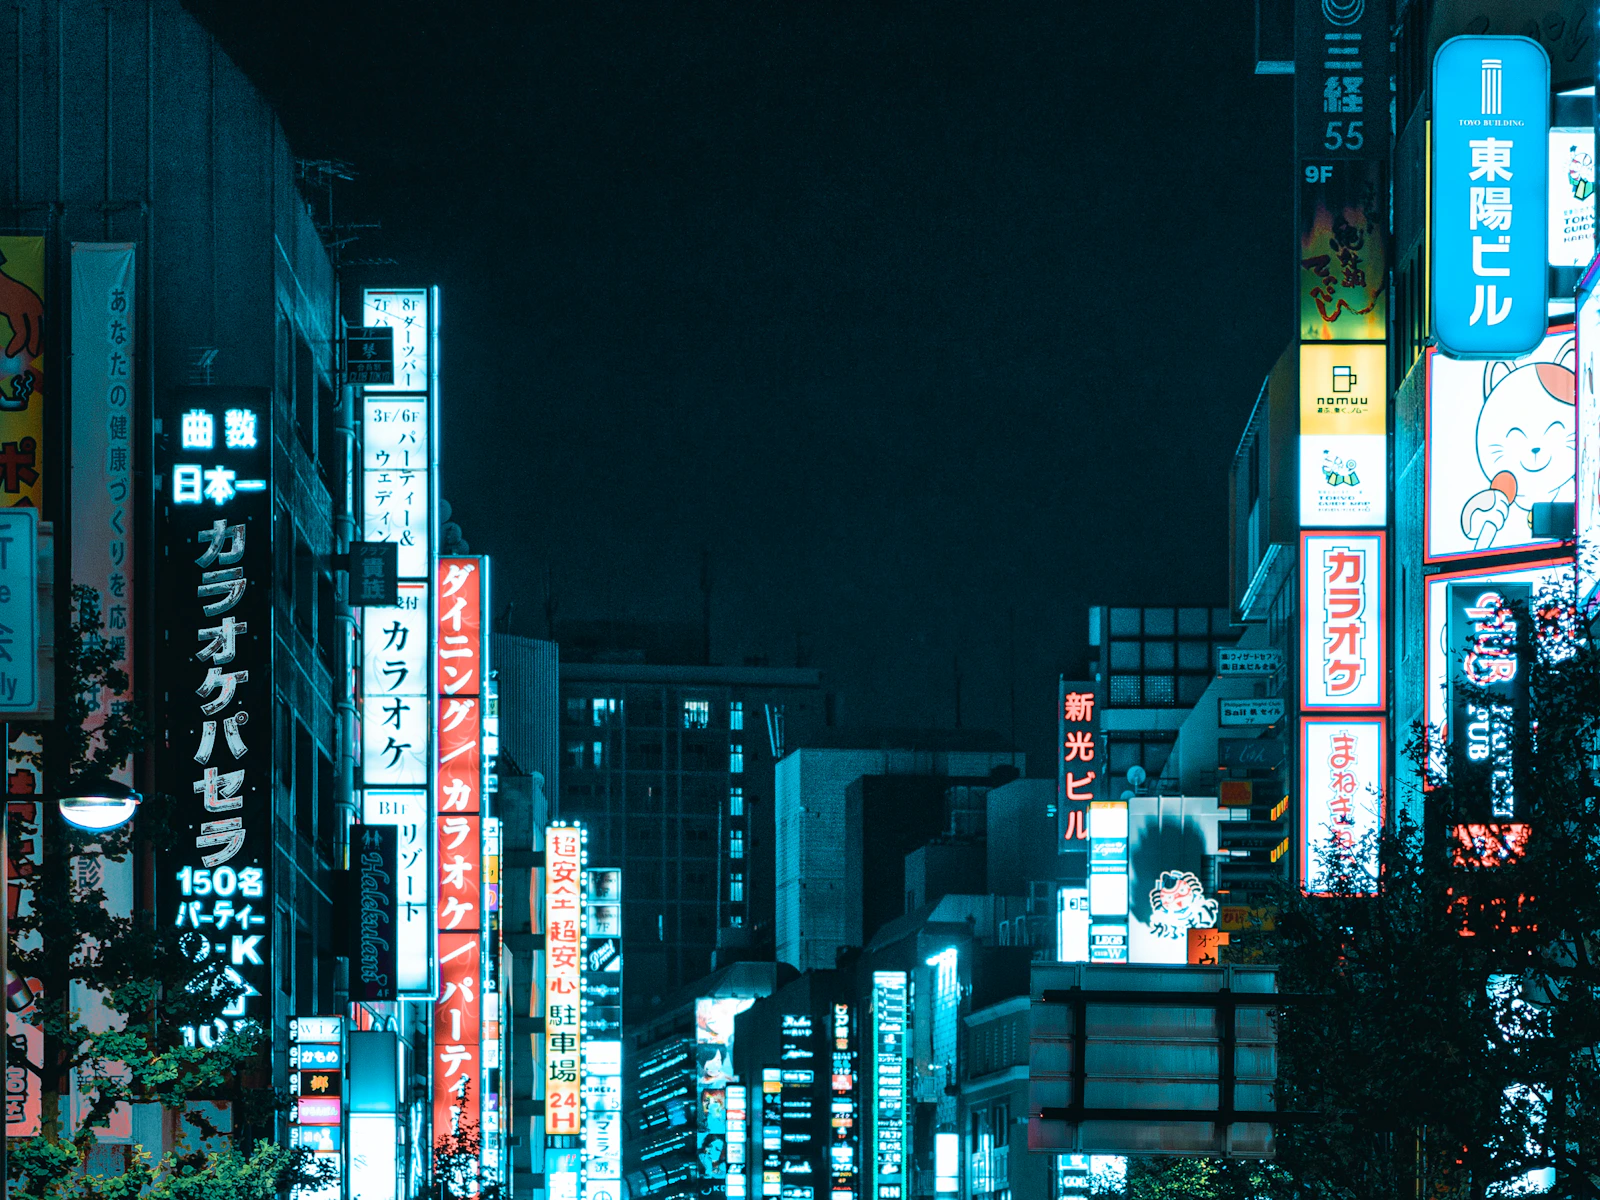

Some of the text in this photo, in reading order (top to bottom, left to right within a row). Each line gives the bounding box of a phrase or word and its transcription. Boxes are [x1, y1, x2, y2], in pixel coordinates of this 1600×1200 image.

[1483, 119, 1525, 127] BUILDING
[1305, 165, 1333, 183] 9F
[1468, 137, 1514, 327] 東陽ビル
[373, 298, 391, 312] 7F
[402, 298, 420, 312] 8F
[402, 315, 417, 387] ダーツバー
[373, 408, 420, 423] 3F/6F
[1317, 397, 1368, 405] nomuu
[181, 409, 257, 448] 曲数
[173, 464, 267, 504] 日本一
[361, 556, 386, 599] 貴族
[1326, 549, 1364, 694] カラオケ
[194, 518, 249, 868] カラオケパセラ
[381, 620, 412, 770] カラオケ
[1064, 691, 1095, 840] 新光ビル
[176, 866, 265, 896] 150名
[402, 823, 424, 923] リゾート
[551, 835, 576, 911] 超安全
[175, 901, 265, 930] パーティー
[360, 851, 389, 984] Halekulani
[551, 919, 576, 995] 超安心
[377, 988, 390, 998] 4F
[301, 1050, 338, 1064] かもめ
[549, 1004, 576, 1082] 駐車場
